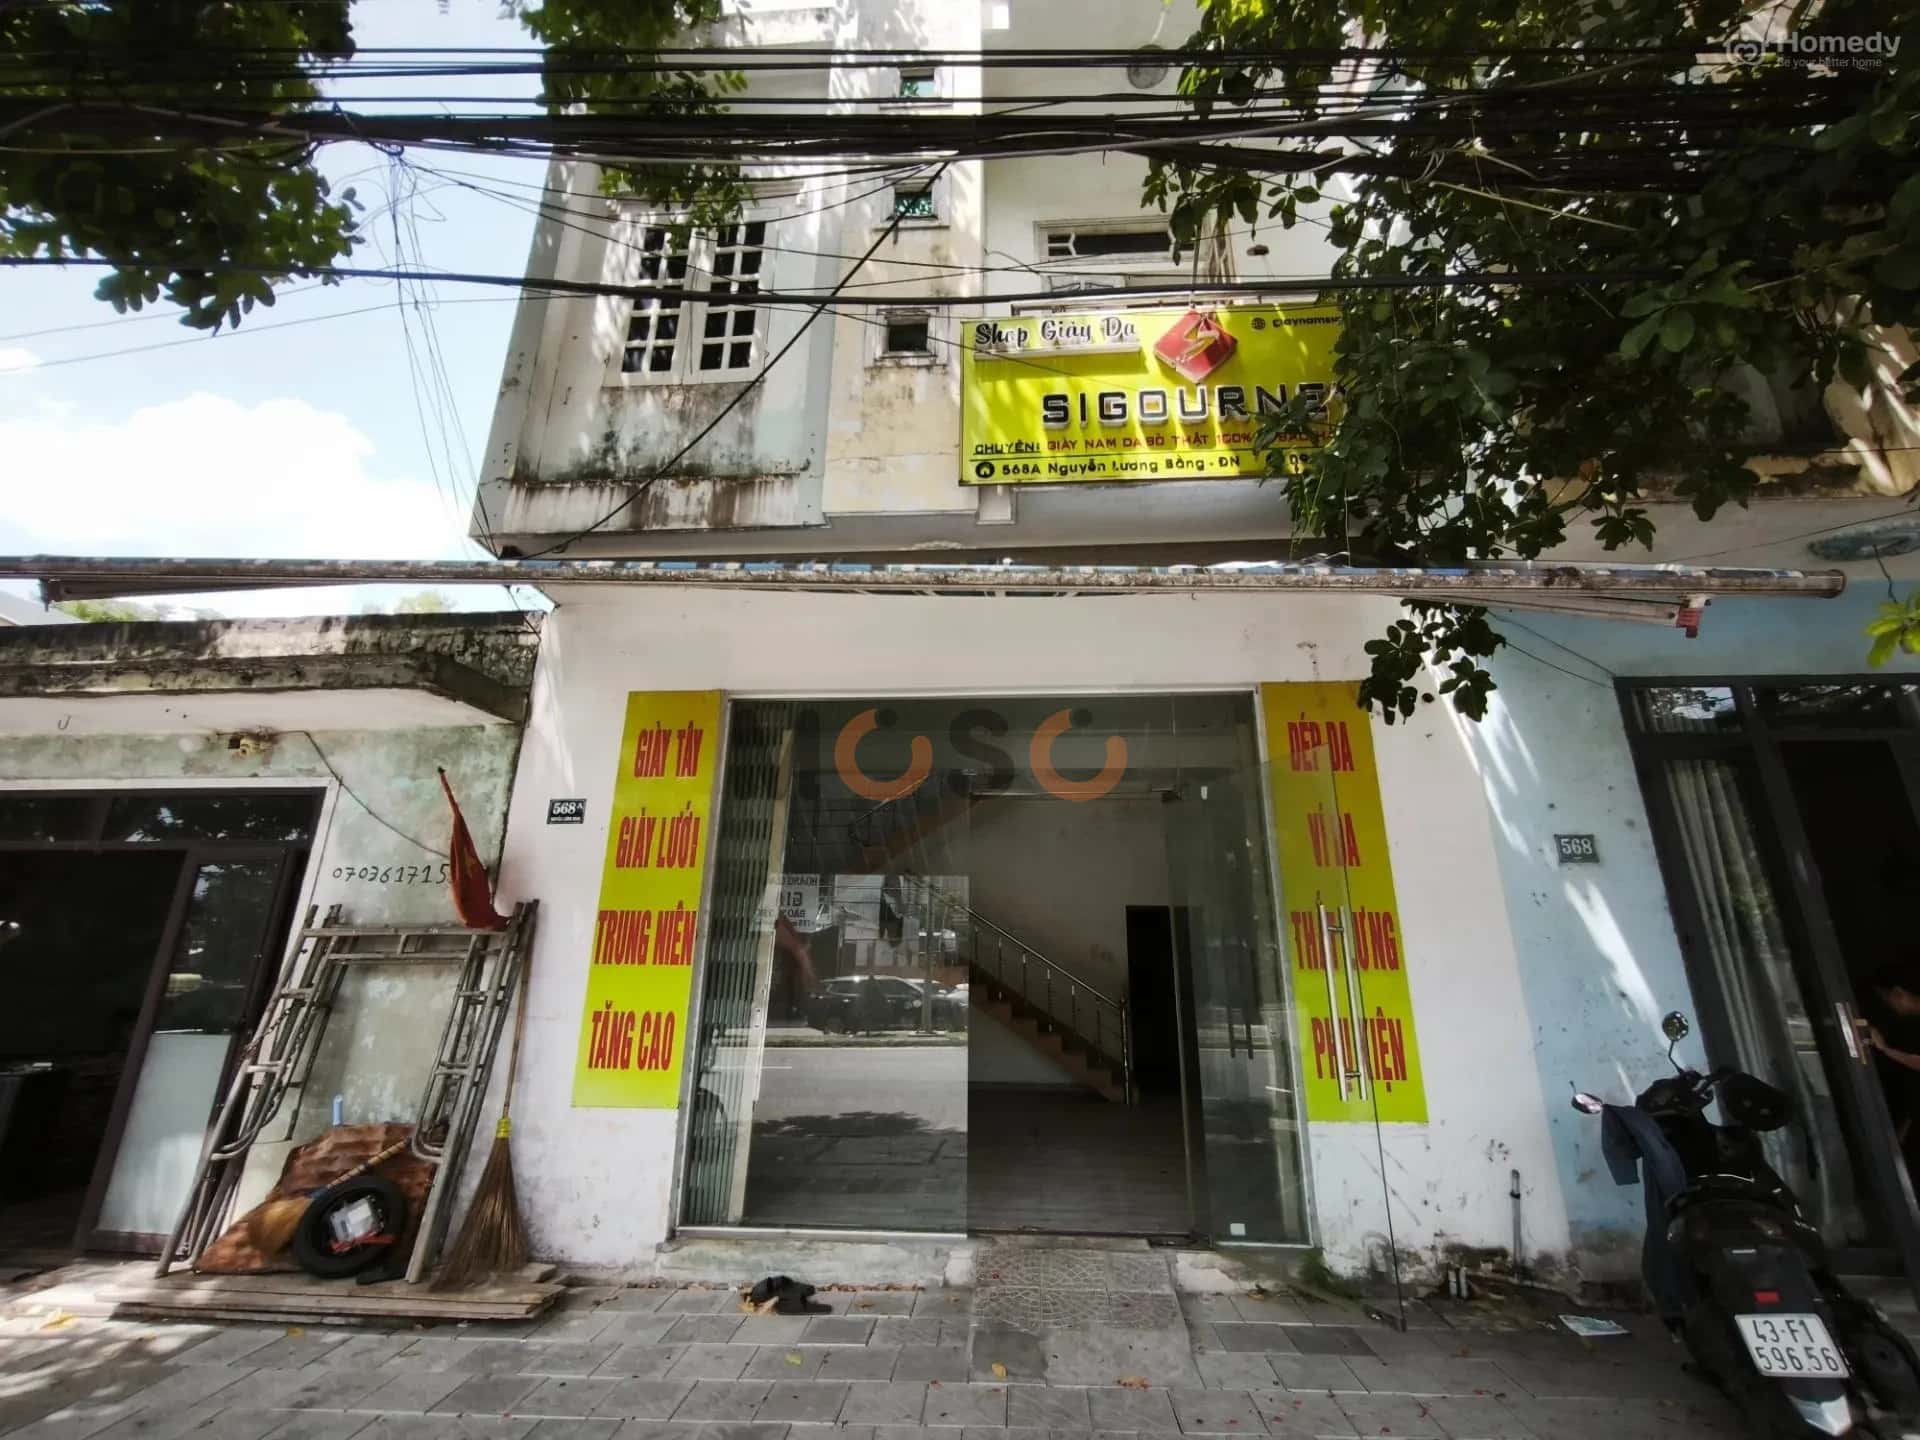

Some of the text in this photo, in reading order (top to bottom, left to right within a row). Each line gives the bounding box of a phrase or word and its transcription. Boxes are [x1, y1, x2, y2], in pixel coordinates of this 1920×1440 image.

[974, 322, 1028, 348] Shop
[1041, 382, 1326, 427] SIGOURNE
[1084, 437, 1116, 449] NAM
[1002, 463, 1041, 475] 568A
[634, 719, 704, 778] GIÀY TÂY
[1325, 721, 1354, 771] DA
[615, 806, 657, 869] GIÀY
[1560, 838, 1593, 855] 568
[332, 863, 452, 884] 070361715
[594, 900, 697, 966] TRUNG NIÊN
[588, 1000, 676, 1071] TĂNG CAO
[1752, 1319, 1815, 1343] 43-F1
[1755, 1346, 1840, 1372] 596.56
